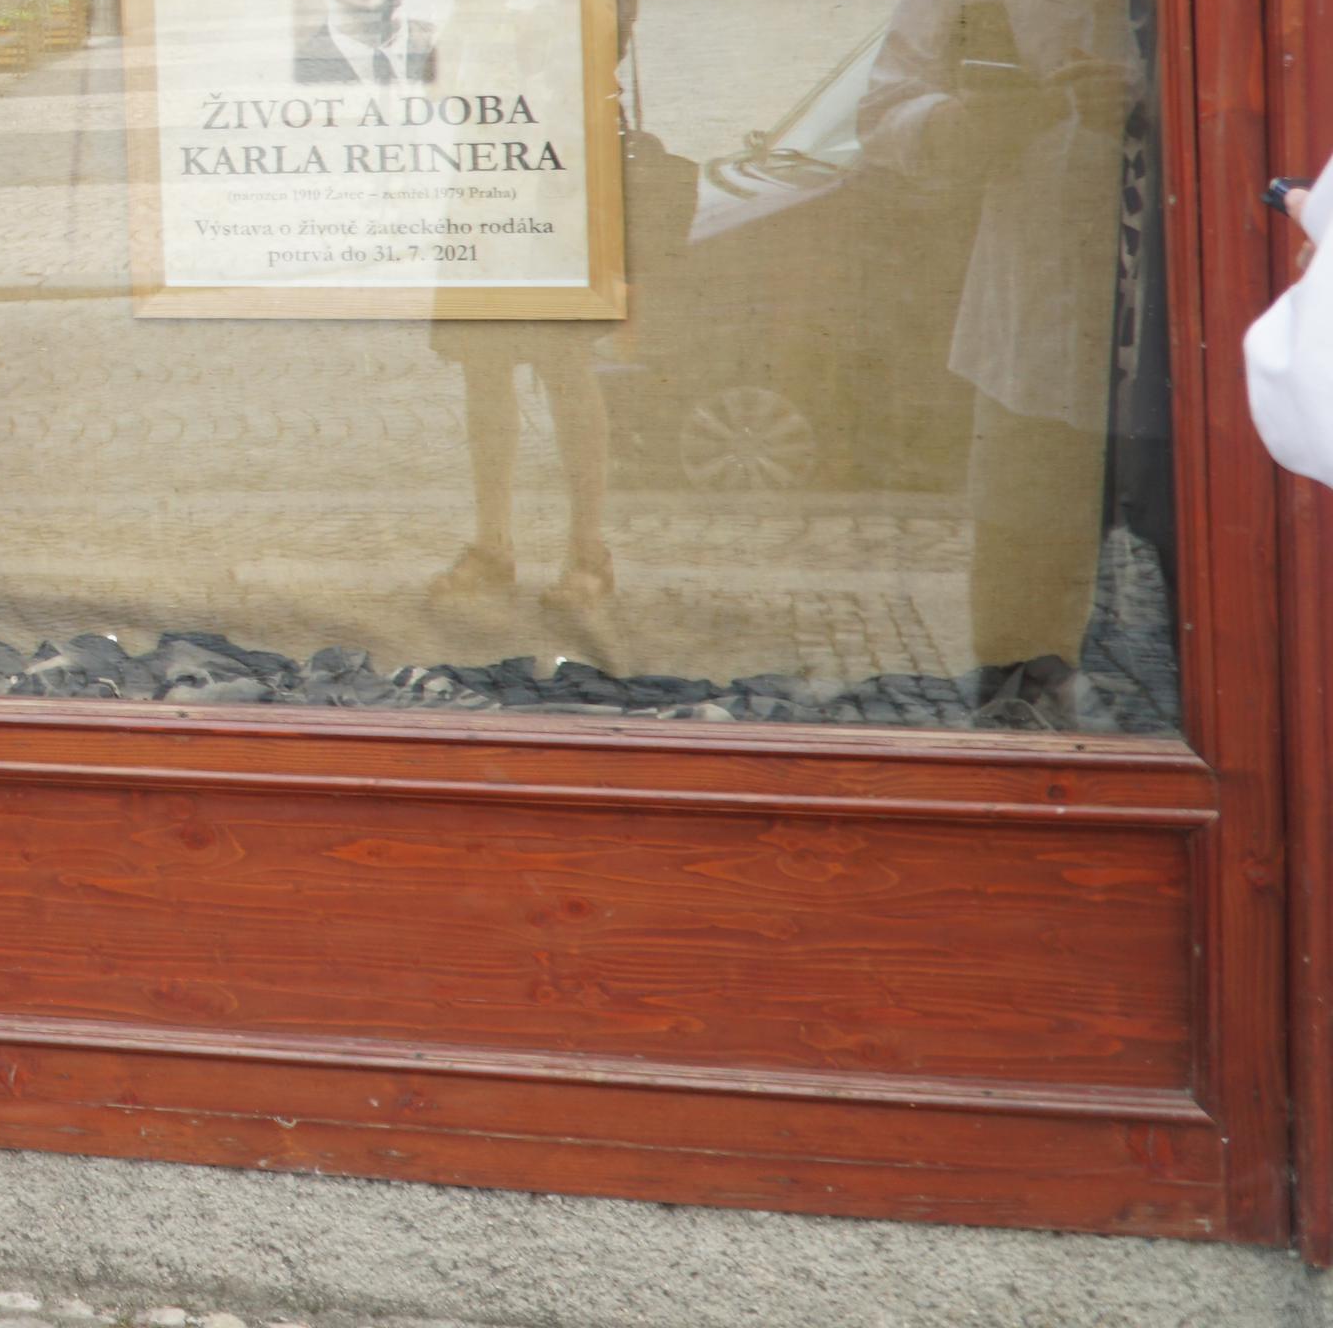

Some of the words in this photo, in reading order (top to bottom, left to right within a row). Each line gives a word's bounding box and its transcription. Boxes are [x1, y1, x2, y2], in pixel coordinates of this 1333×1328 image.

[201, 92, 344, 131] ŽIVOT
[357, 96, 389, 128] A
[400, 93, 539, 127] DOBA
[180, 143, 331, 176] KARLA
[343, 141, 567, 174] REINERA
[434, 185, 466, 201] 1979
[468, 185, 517, 202] Praha)
[195, 218, 273, 241] Výstava
[279, 225, 291, 237] o
[297, 217, 358, 240] životě
[365, 216, 473, 237] žateckého
[479, 216, 554, 236] rodáka
[268, 246, 333, 268] potrvá
[340, 244, 367, 263] do
[372, 244, 402, 263] 31.
[408, 245, 426, 262] 7.
[433, 243, 478, 261] 2021
